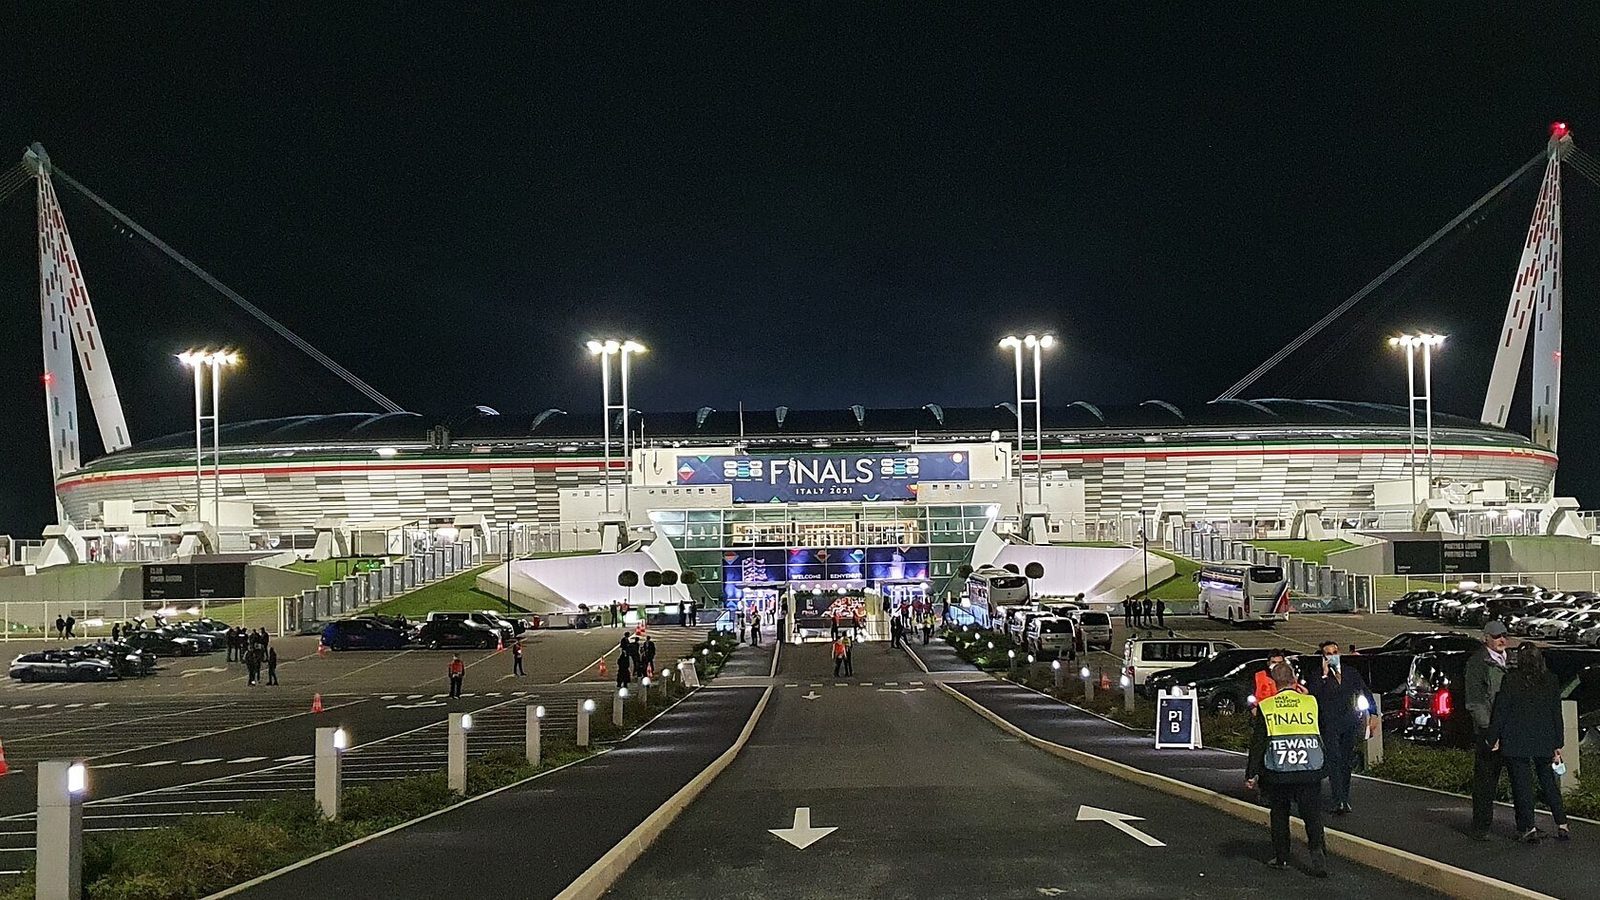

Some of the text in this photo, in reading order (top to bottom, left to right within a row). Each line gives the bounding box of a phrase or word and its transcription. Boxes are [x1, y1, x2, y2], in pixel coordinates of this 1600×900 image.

[770, 457, 874, 485] FINALS
[1168, 710, 1182, 722] P1
[1266, 712, 1314, 727] FINALS
[1171, 722, 1180, 733] B
[1269, 739, 1318, 750] TEWARD
[1277, 749, 1308, 765] 782
